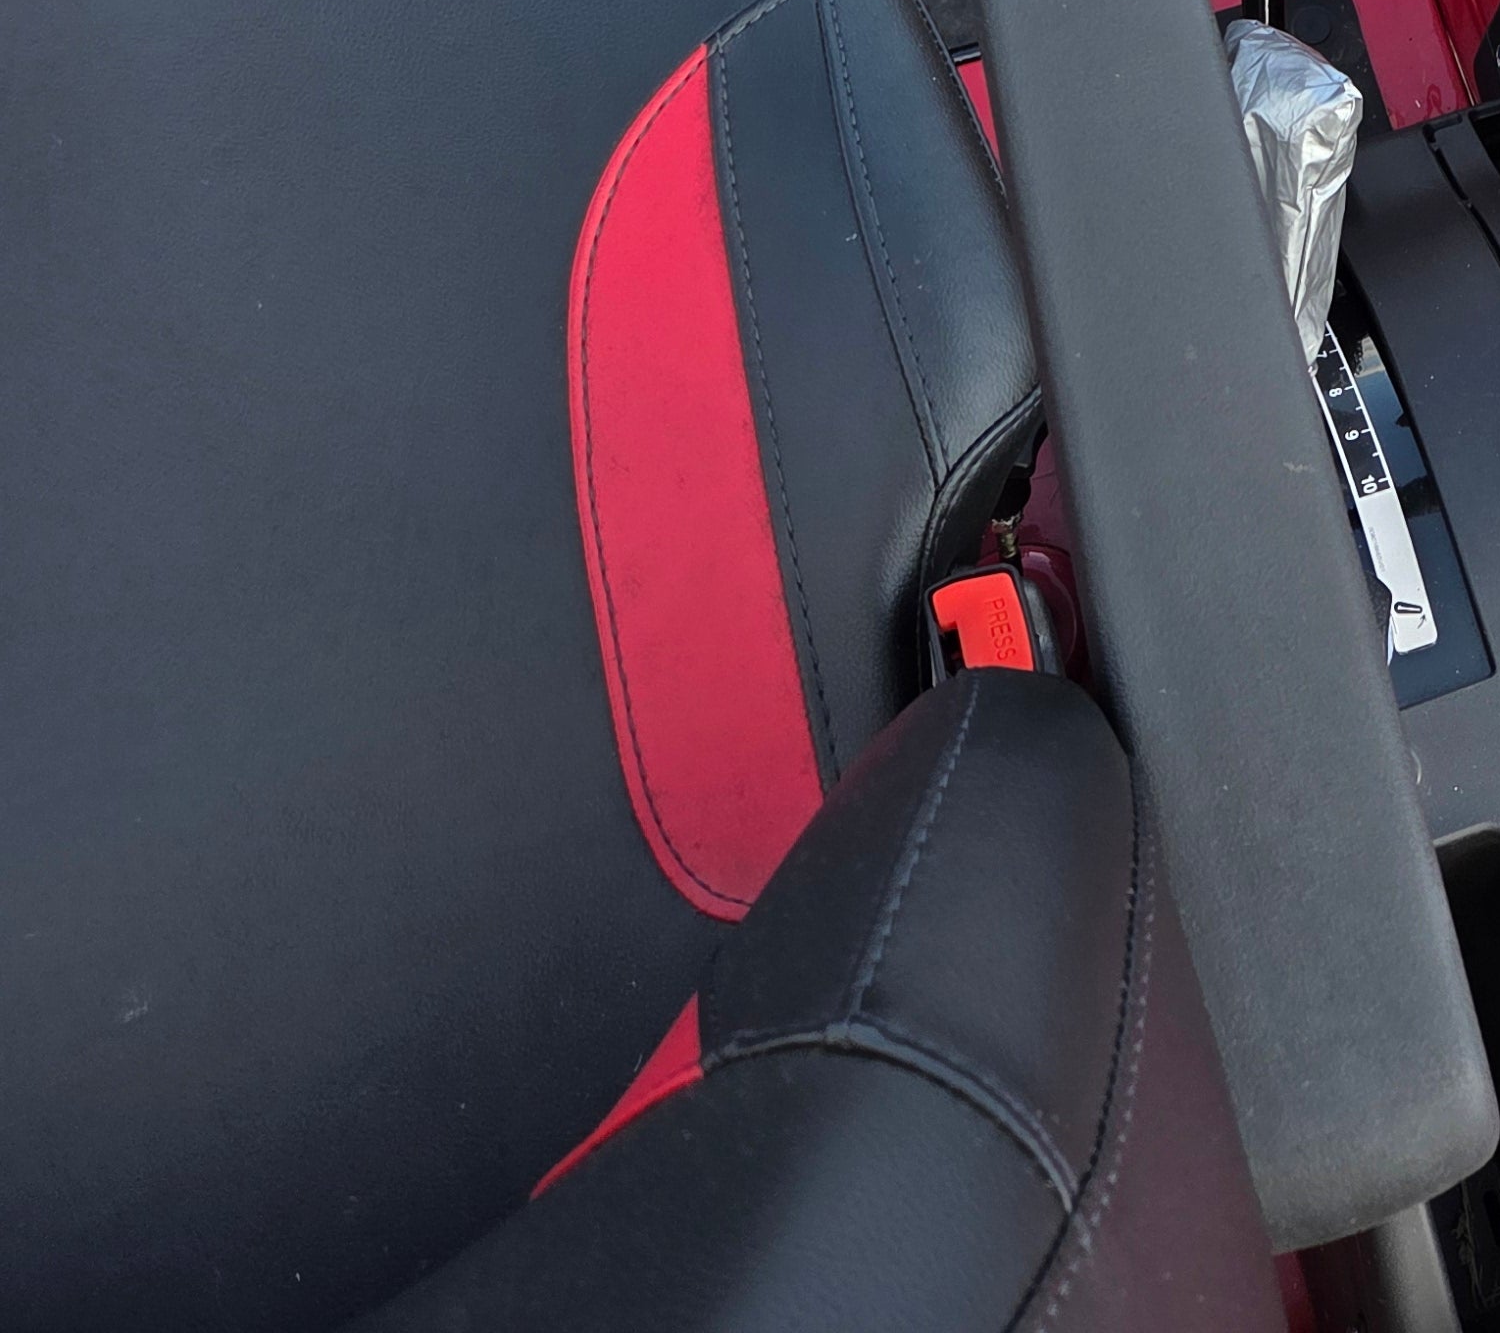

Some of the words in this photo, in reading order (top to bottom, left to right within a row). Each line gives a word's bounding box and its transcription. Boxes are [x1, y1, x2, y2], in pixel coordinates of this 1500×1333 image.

[1329, 387, 1343, 398] 8
[1344, 429, 1360, 441] 9
[1361, 474, 1378, 494] 10
[989, 597, 1017, 661] PRESS
